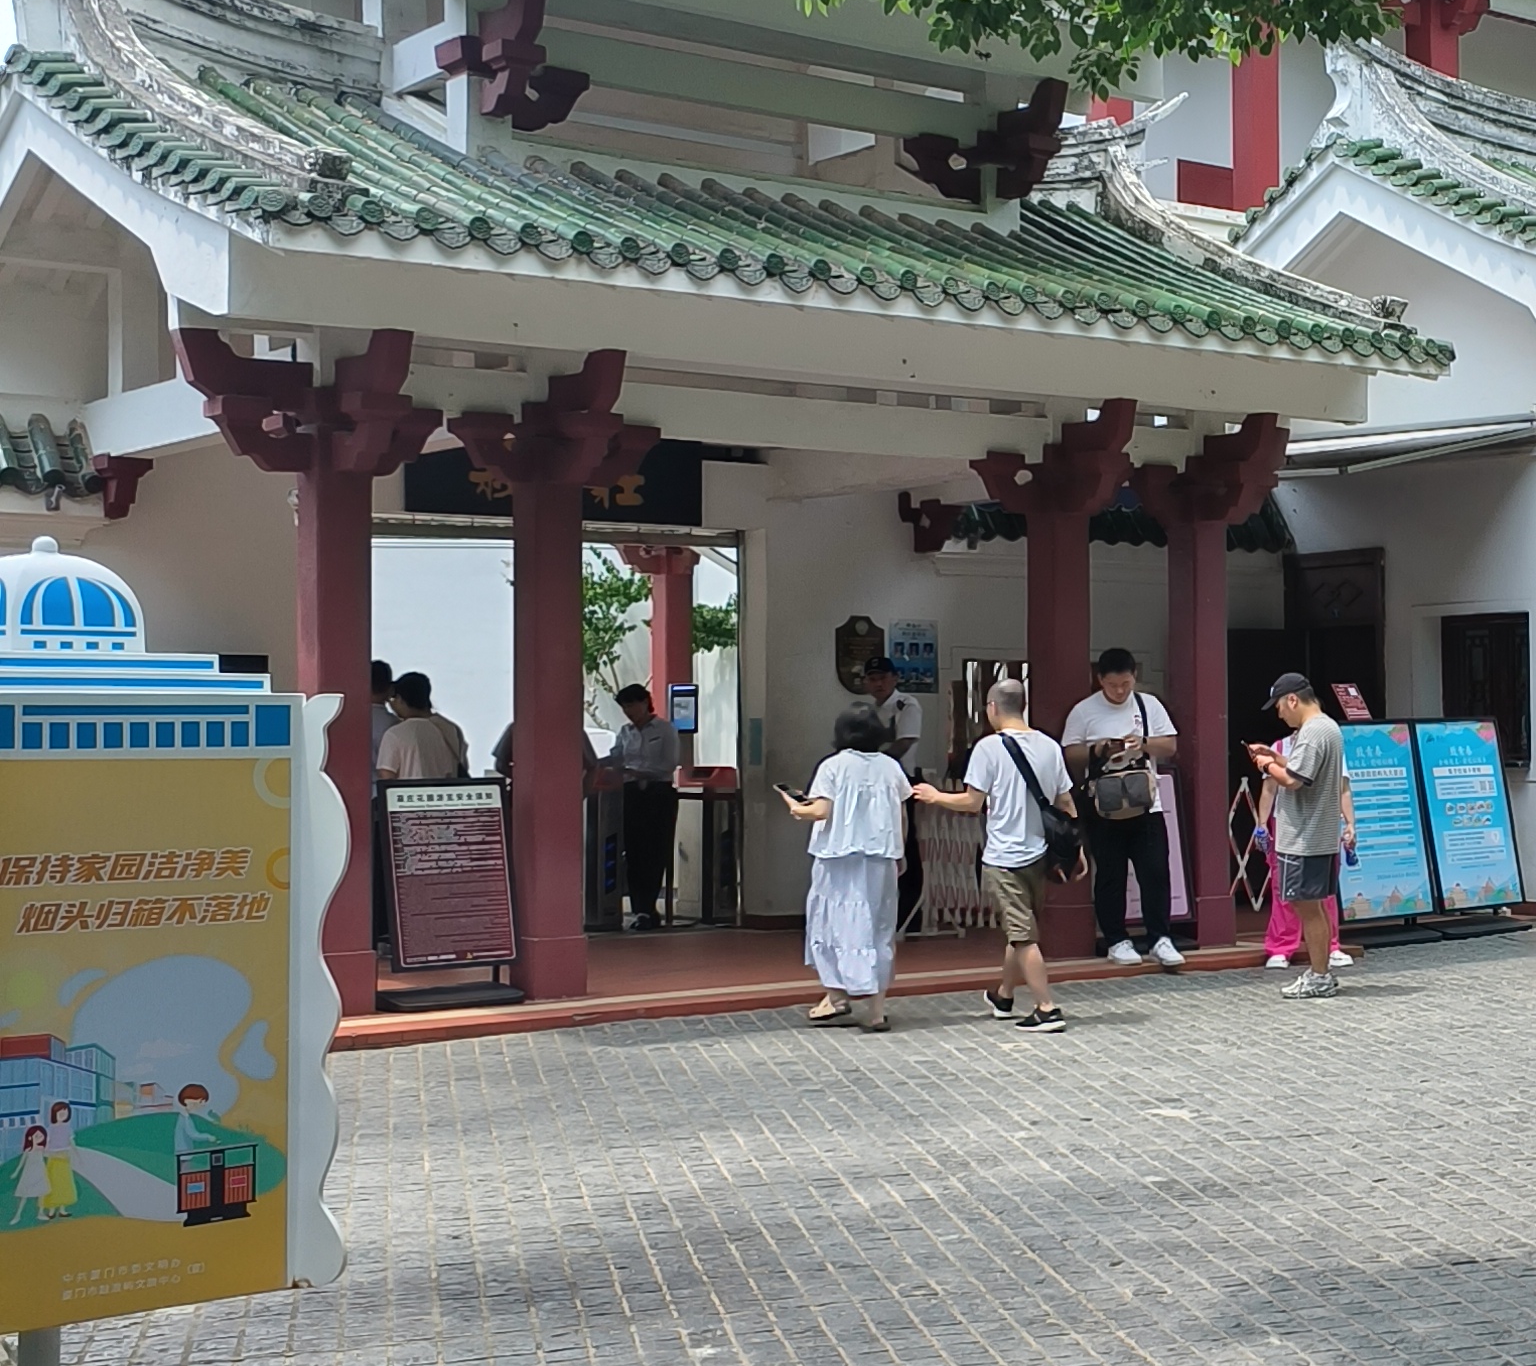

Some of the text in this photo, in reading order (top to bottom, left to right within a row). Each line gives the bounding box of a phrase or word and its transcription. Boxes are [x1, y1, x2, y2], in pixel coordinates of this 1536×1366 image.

[0, 847, 251, 887] 保持家园洁净美
[16, 891, 272, 935] 烟头归箱不落地
